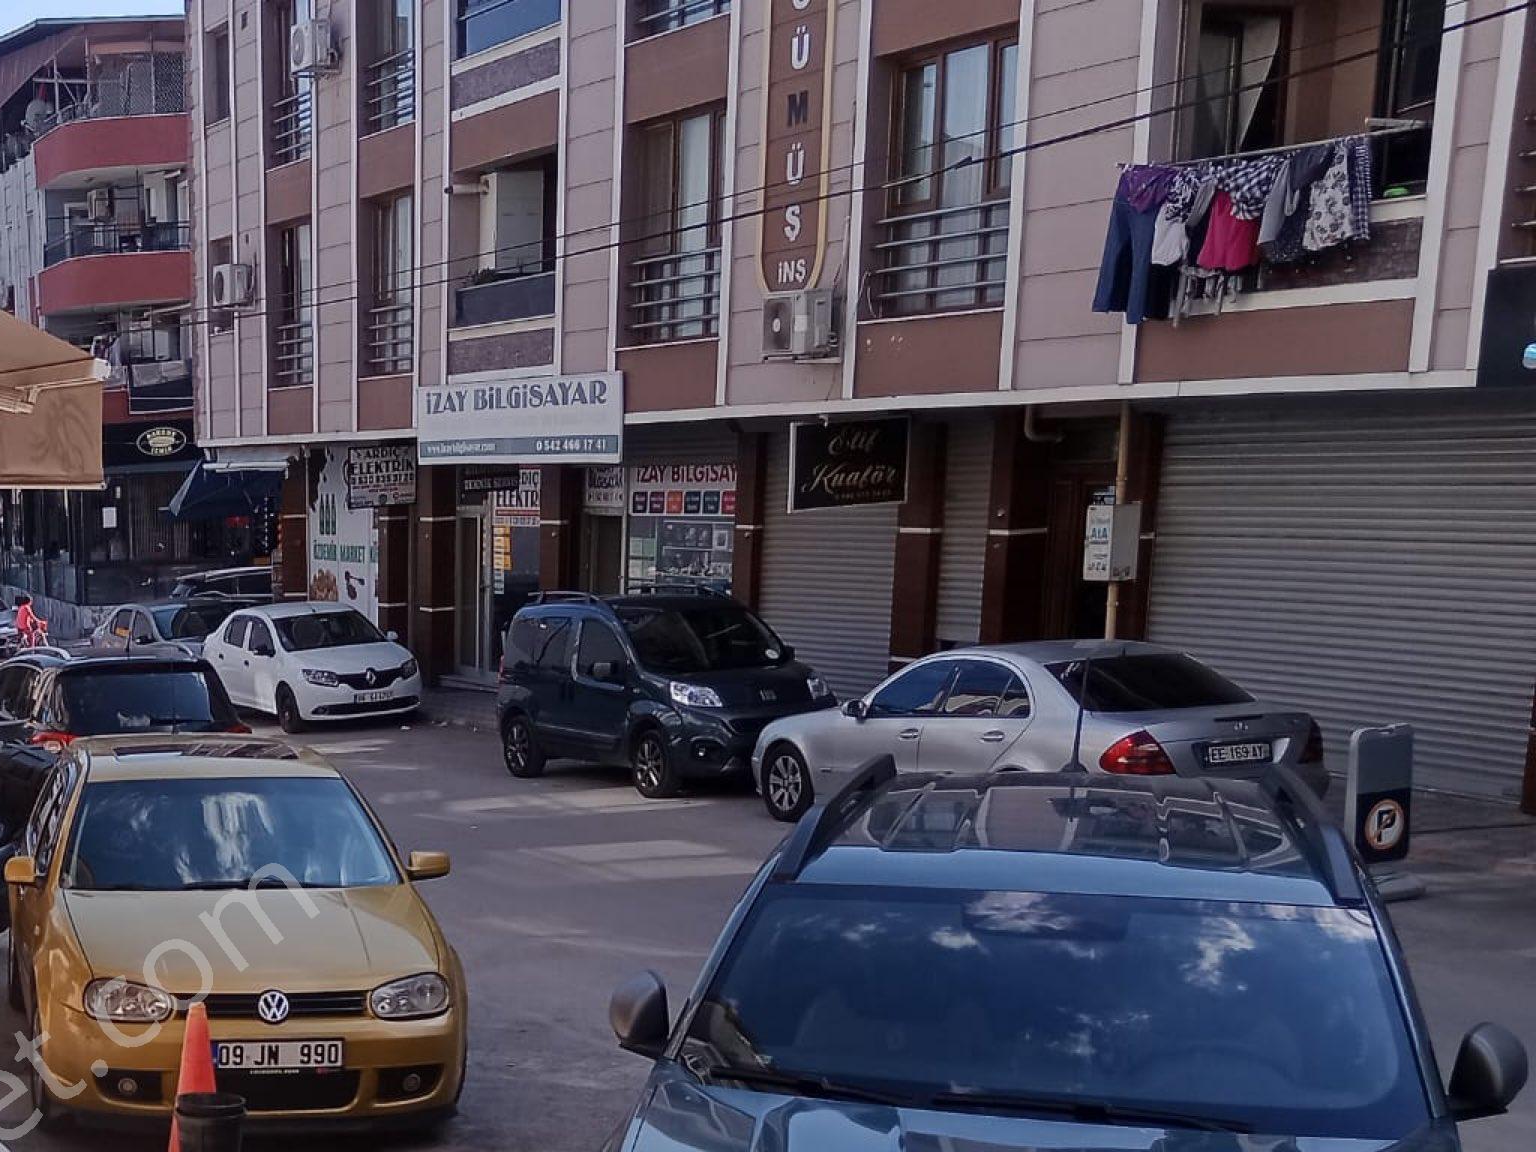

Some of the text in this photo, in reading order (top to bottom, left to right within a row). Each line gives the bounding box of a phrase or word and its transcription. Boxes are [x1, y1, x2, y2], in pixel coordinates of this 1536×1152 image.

[778, 258, 806, 283] İNŞ
[473, 380, 607, 411] BİLGİSAYAR
[219, 1043, 339, 1066] 09 JN 990
